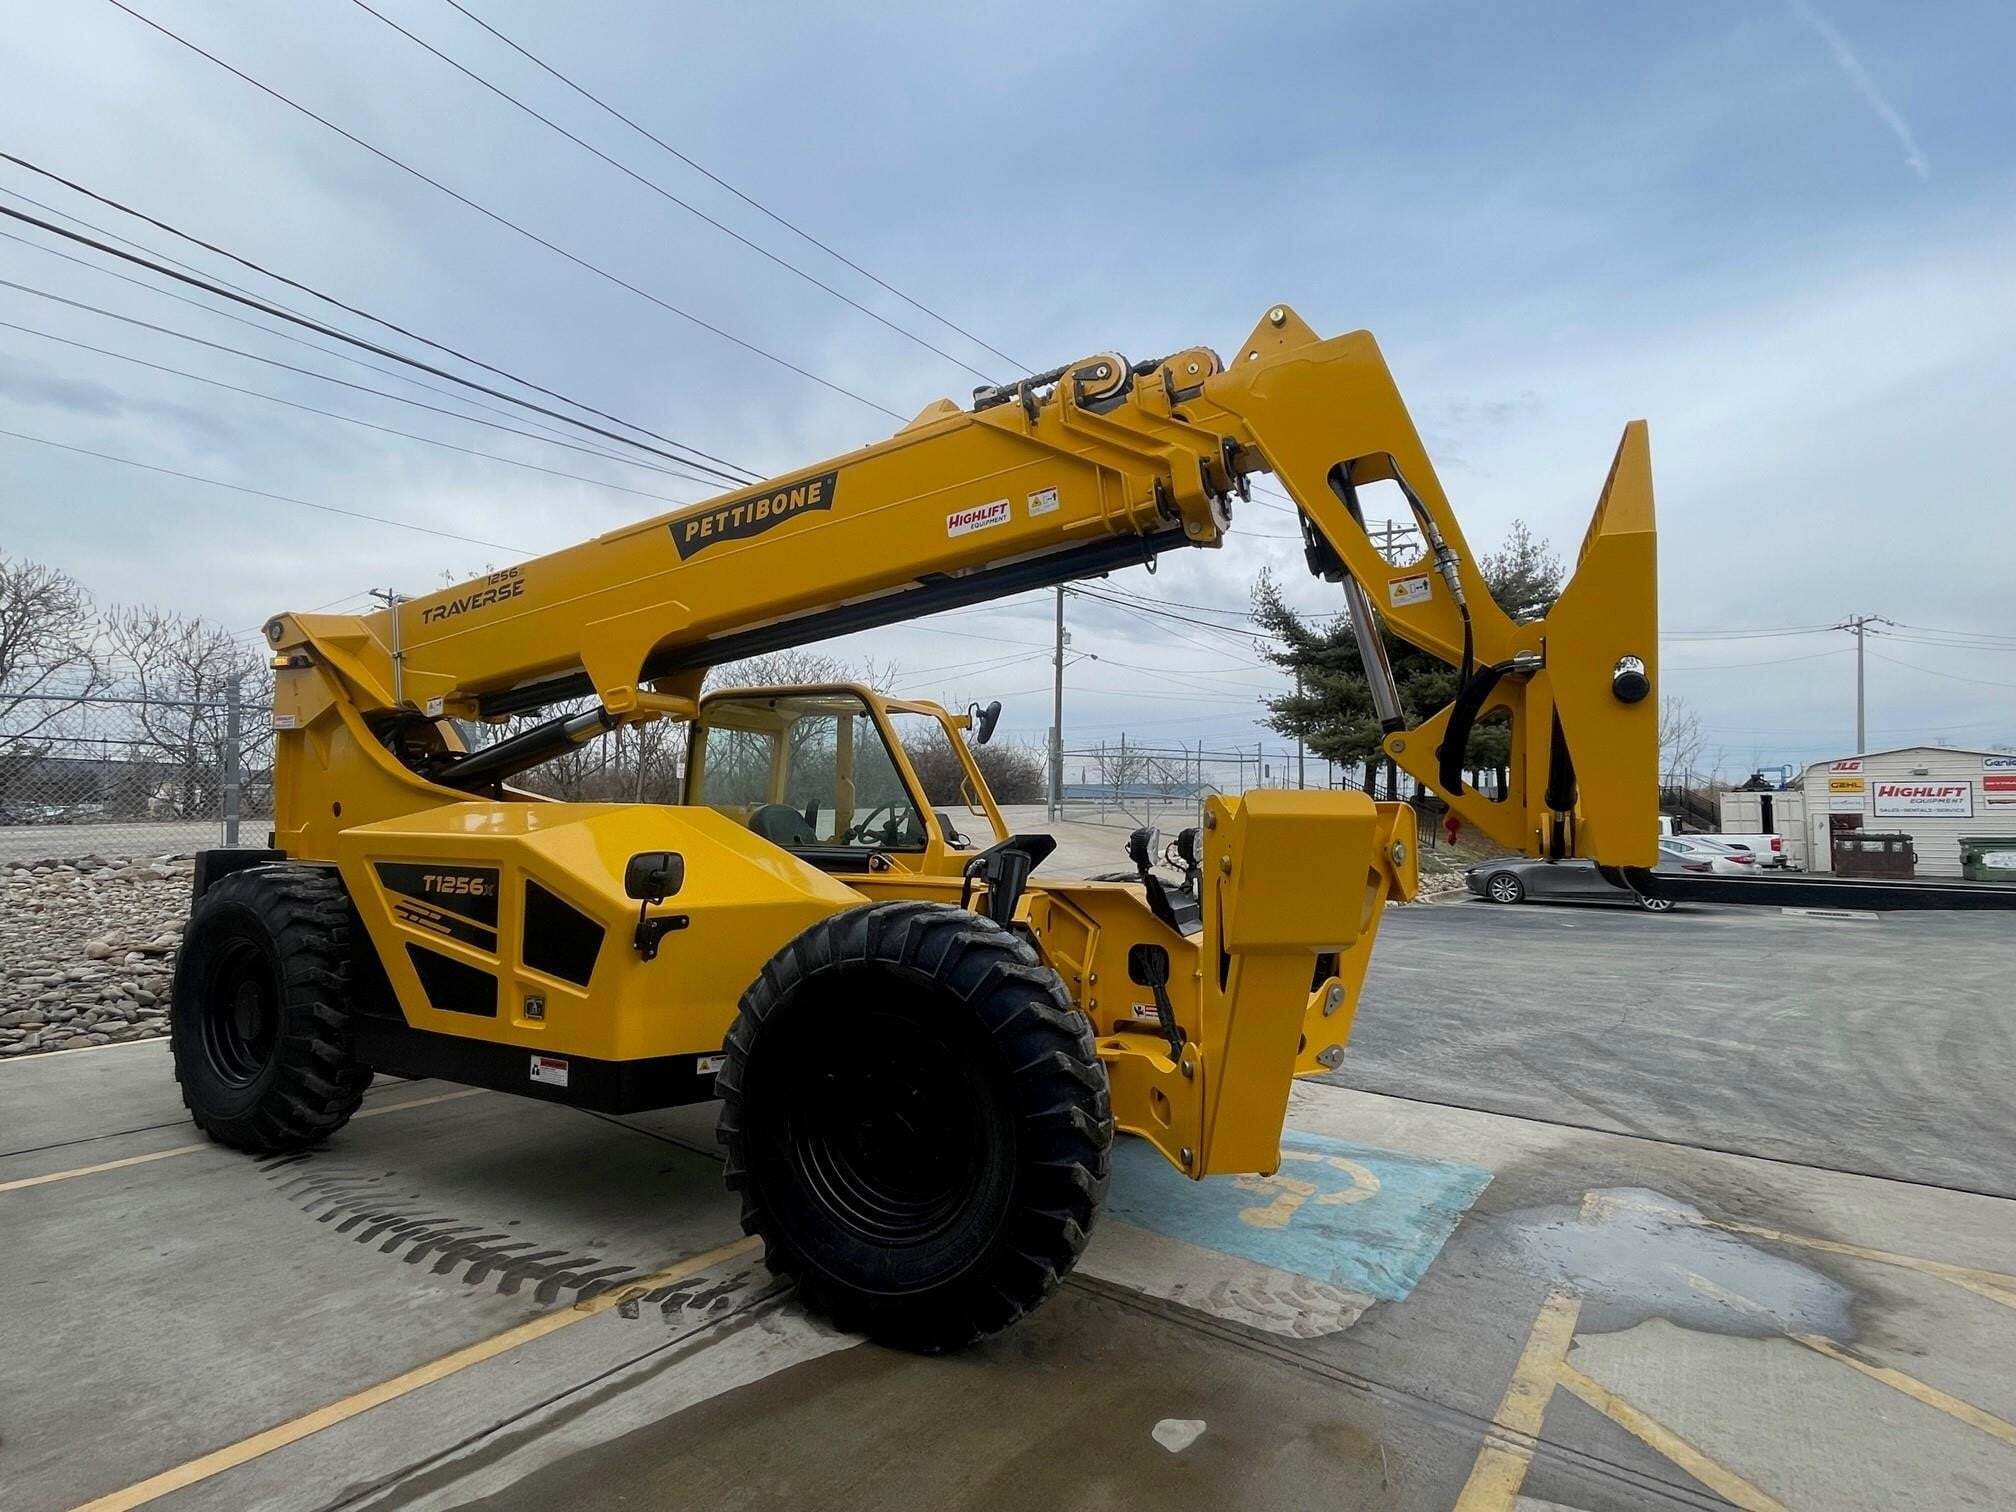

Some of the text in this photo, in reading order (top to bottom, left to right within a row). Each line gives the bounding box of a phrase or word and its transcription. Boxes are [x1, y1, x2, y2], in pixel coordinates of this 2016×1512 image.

[684, 480, 823, 543] PETTIBONE
[948, 502, 1008, 529] HIGHLIFT
[970, 514, 1008, 530] EQUIPMENT
[421, 578, 525, 625] TRAVERSE
[1831, 762, 1861, 770] JLG
[1878, 786, 1967, 797] HIGHLIFT
